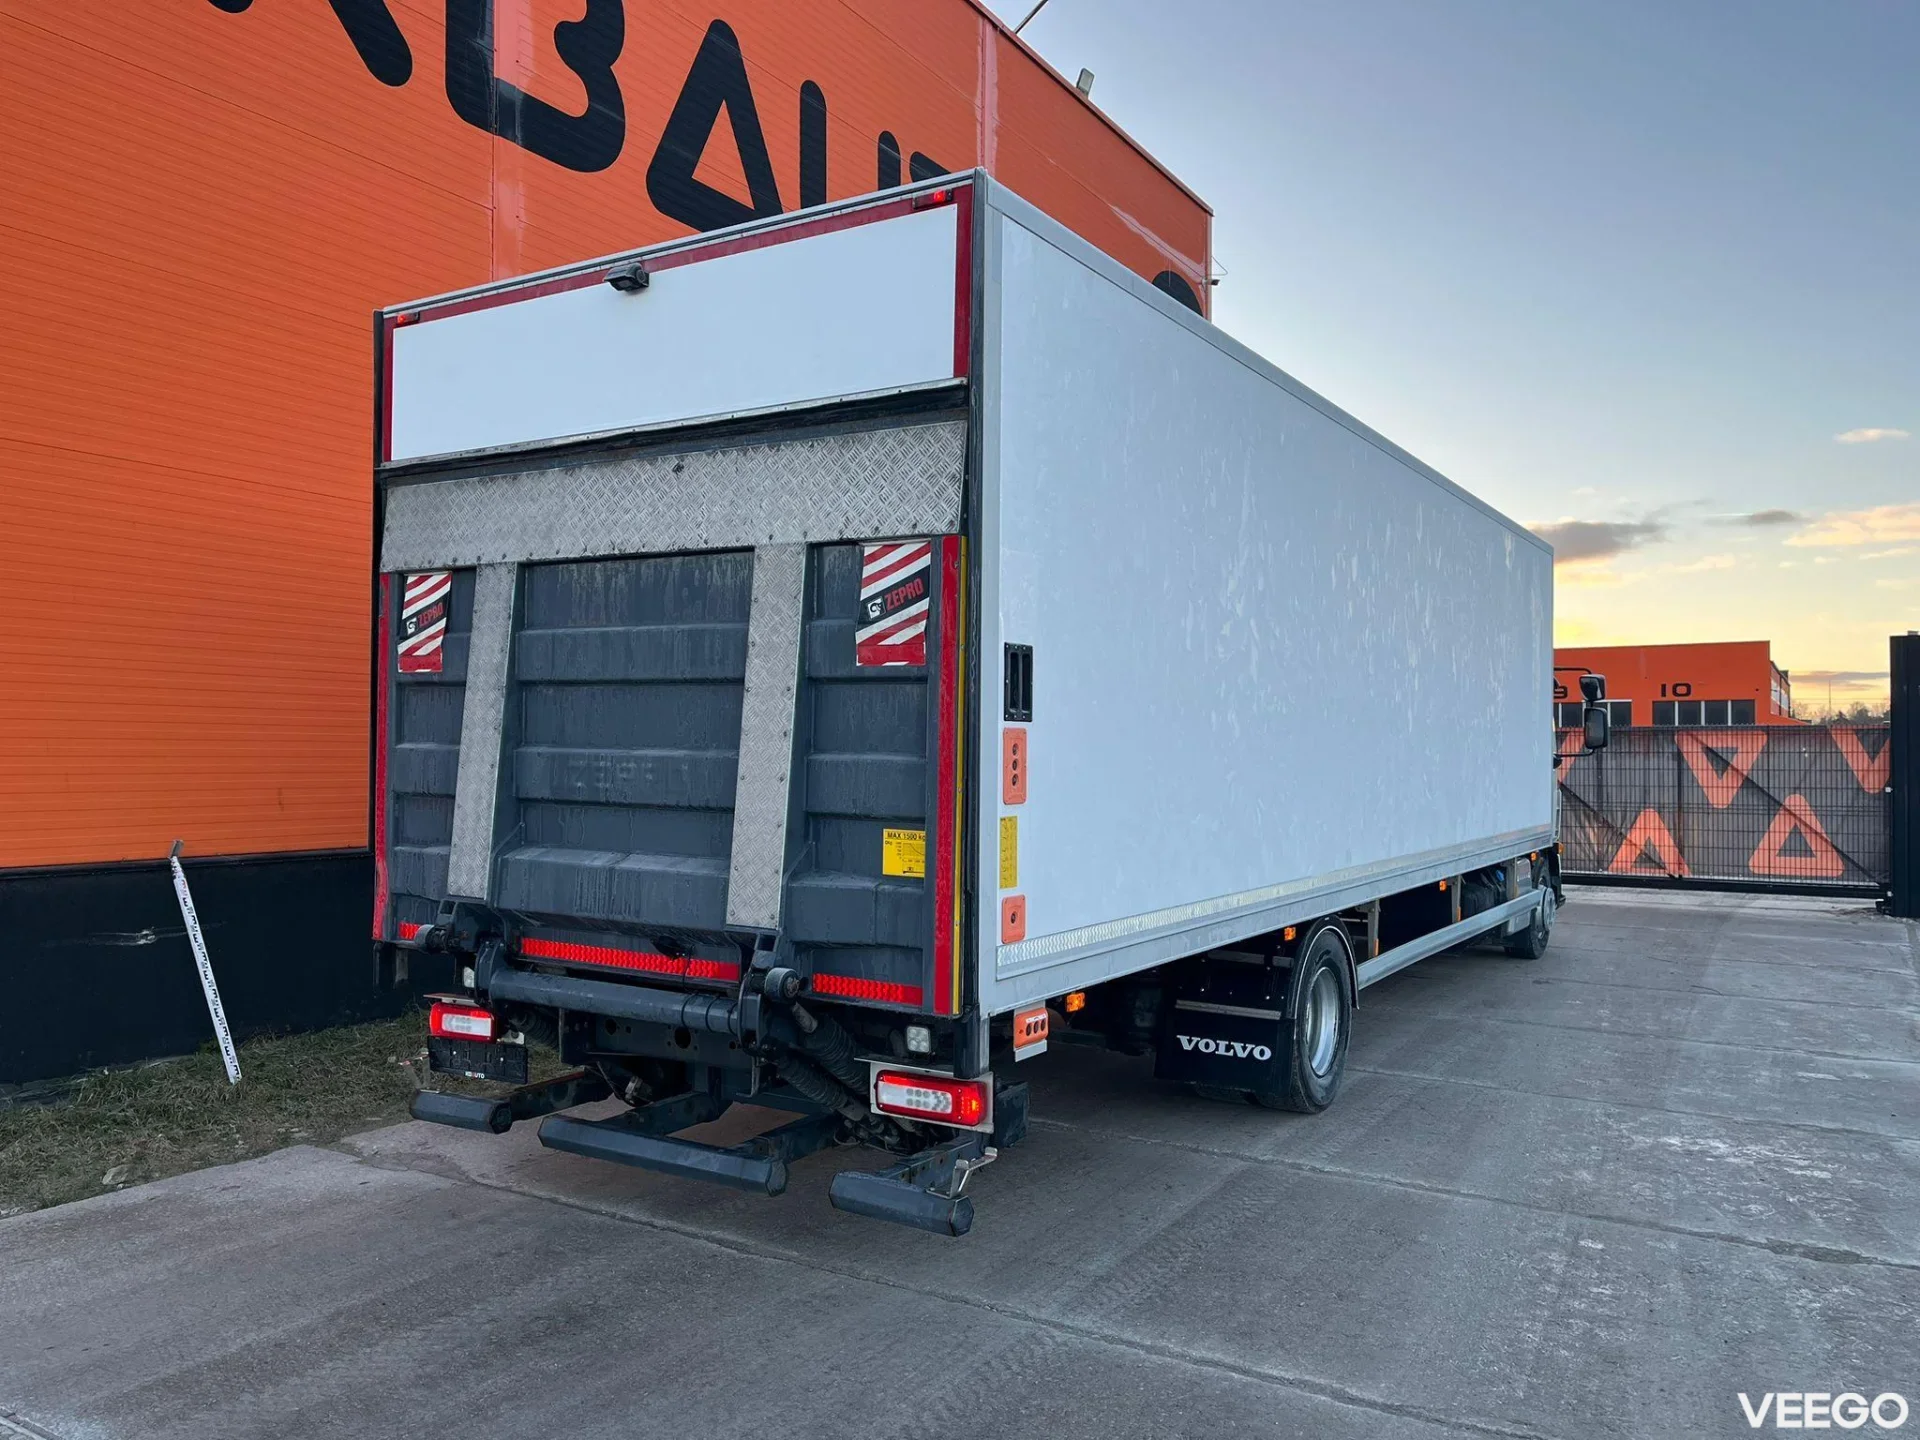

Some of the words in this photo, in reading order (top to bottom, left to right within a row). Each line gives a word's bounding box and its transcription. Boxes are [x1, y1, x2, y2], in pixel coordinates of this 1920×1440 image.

[885, 579, 924, 611] ZEPRO
[418, 602, 444, 629] ZEPRO
[1661, 683, 1692, 698] 10
[1176, 1034, 1272, 1061] VOLVO
